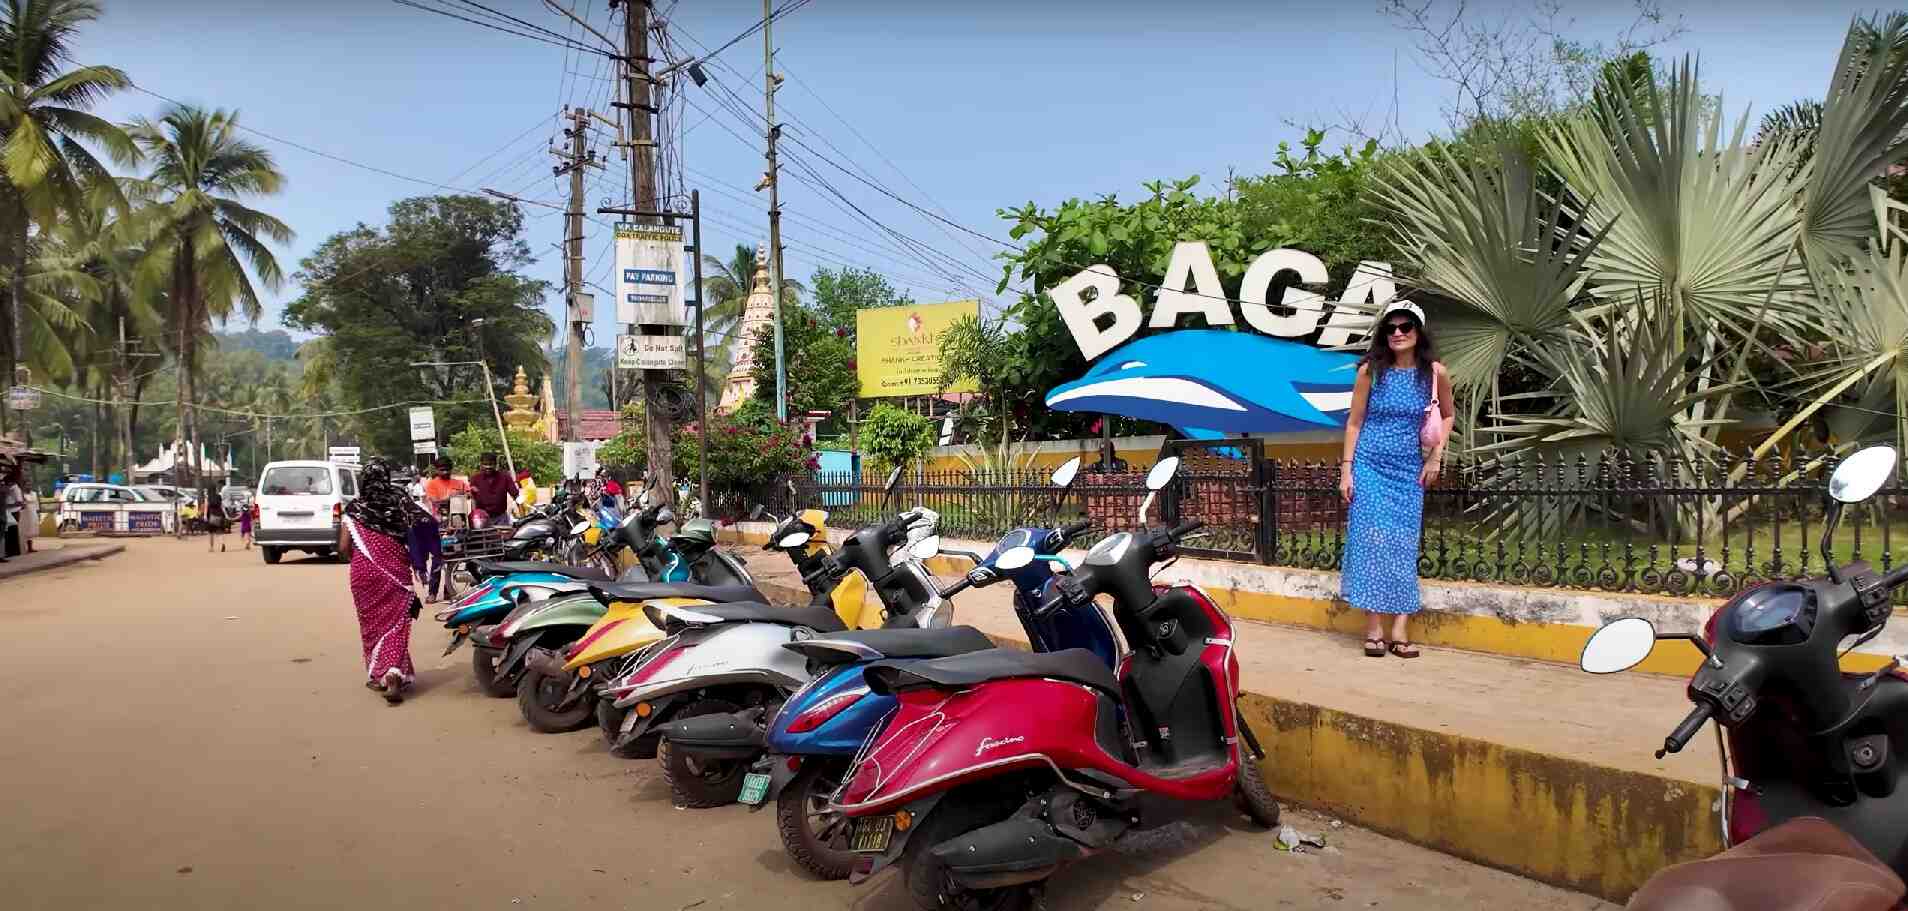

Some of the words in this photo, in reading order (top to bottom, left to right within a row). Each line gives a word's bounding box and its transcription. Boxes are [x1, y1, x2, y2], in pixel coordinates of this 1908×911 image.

[626, 272, 640, 281] PAY
[641, 272, 673, 283] PARKING
[1049, 241, 1397, 361] BAGA
[644, 344, 654, 352] Do
[656, 344, 668, 352] Not
[669, 344, 683, 353] Spit
